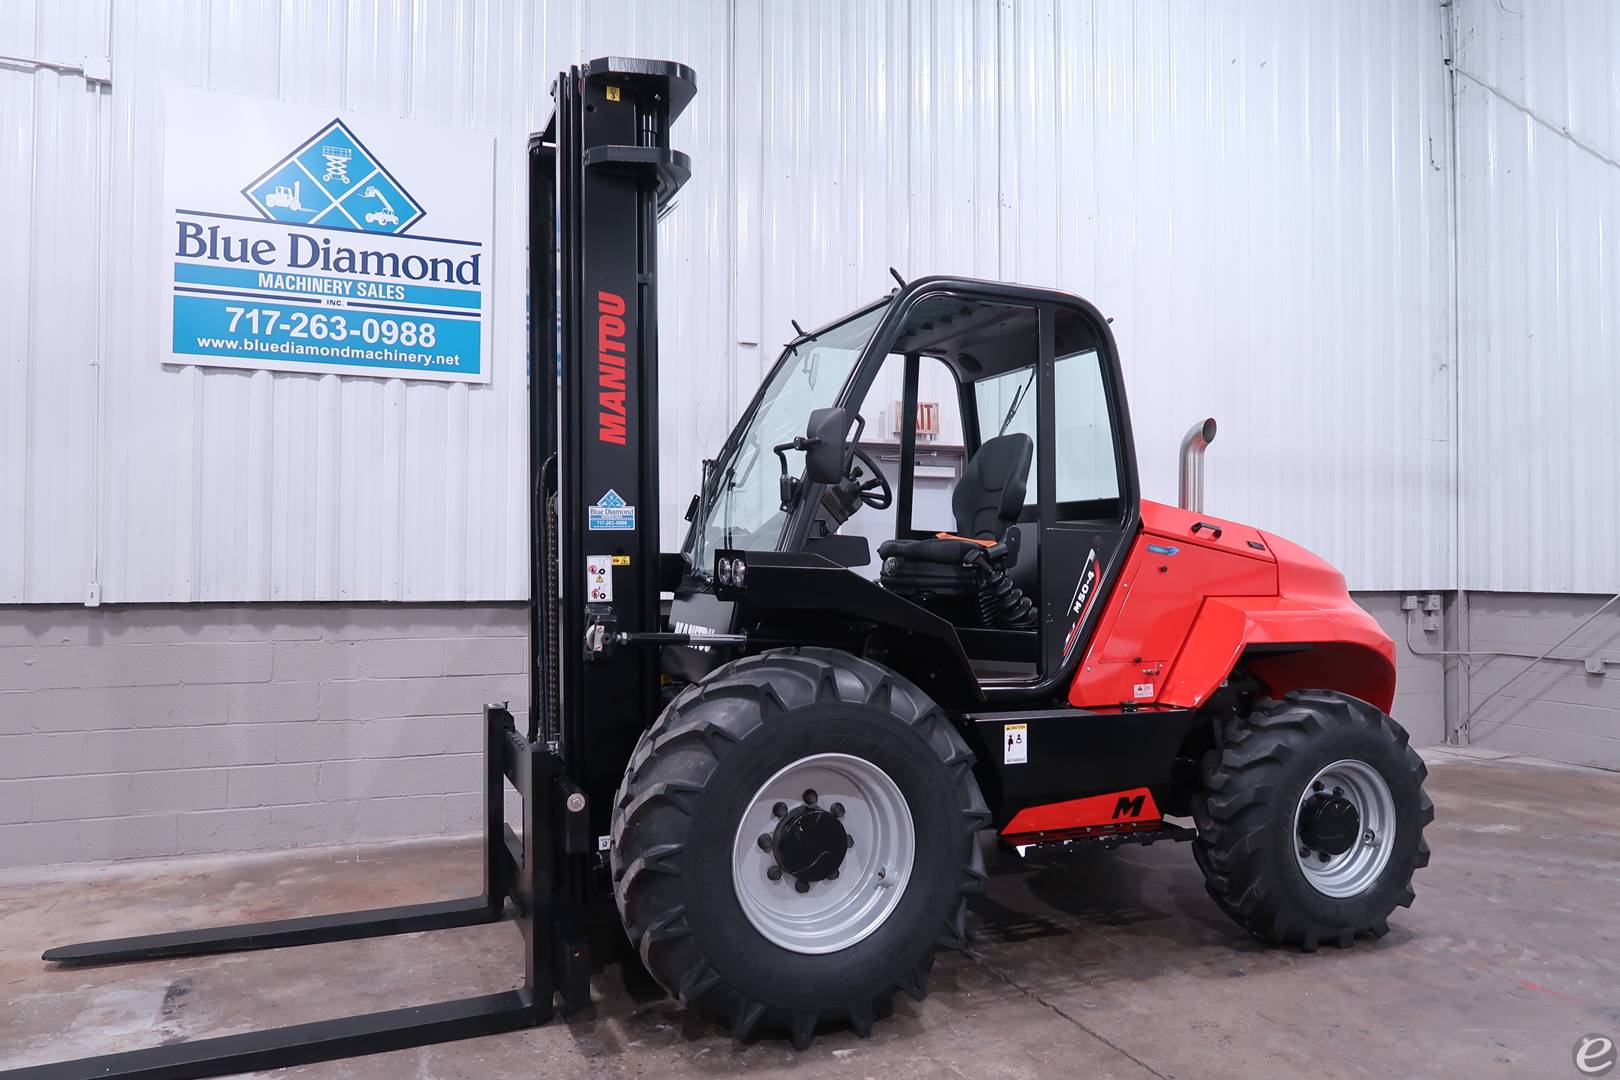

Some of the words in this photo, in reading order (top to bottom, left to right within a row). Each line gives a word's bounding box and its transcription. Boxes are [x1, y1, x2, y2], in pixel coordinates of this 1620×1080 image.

[175, 221, 276, 265] Blue
[287, 233, 481, 286] Diamond
[258, 272, 352, 296] MACHINERY
[357, 282, 405, 300] SALES
[326, 299, 345, 307] INC.
[225, 306, 436, 348] 717-263-0988
[197, 335, 460, 366] www.bluediamondmachinery.net
[598, 290, 626, 445] MANITOU
[915, 404, 933, 430] IT
[1112, 795, 1146, 819] M
